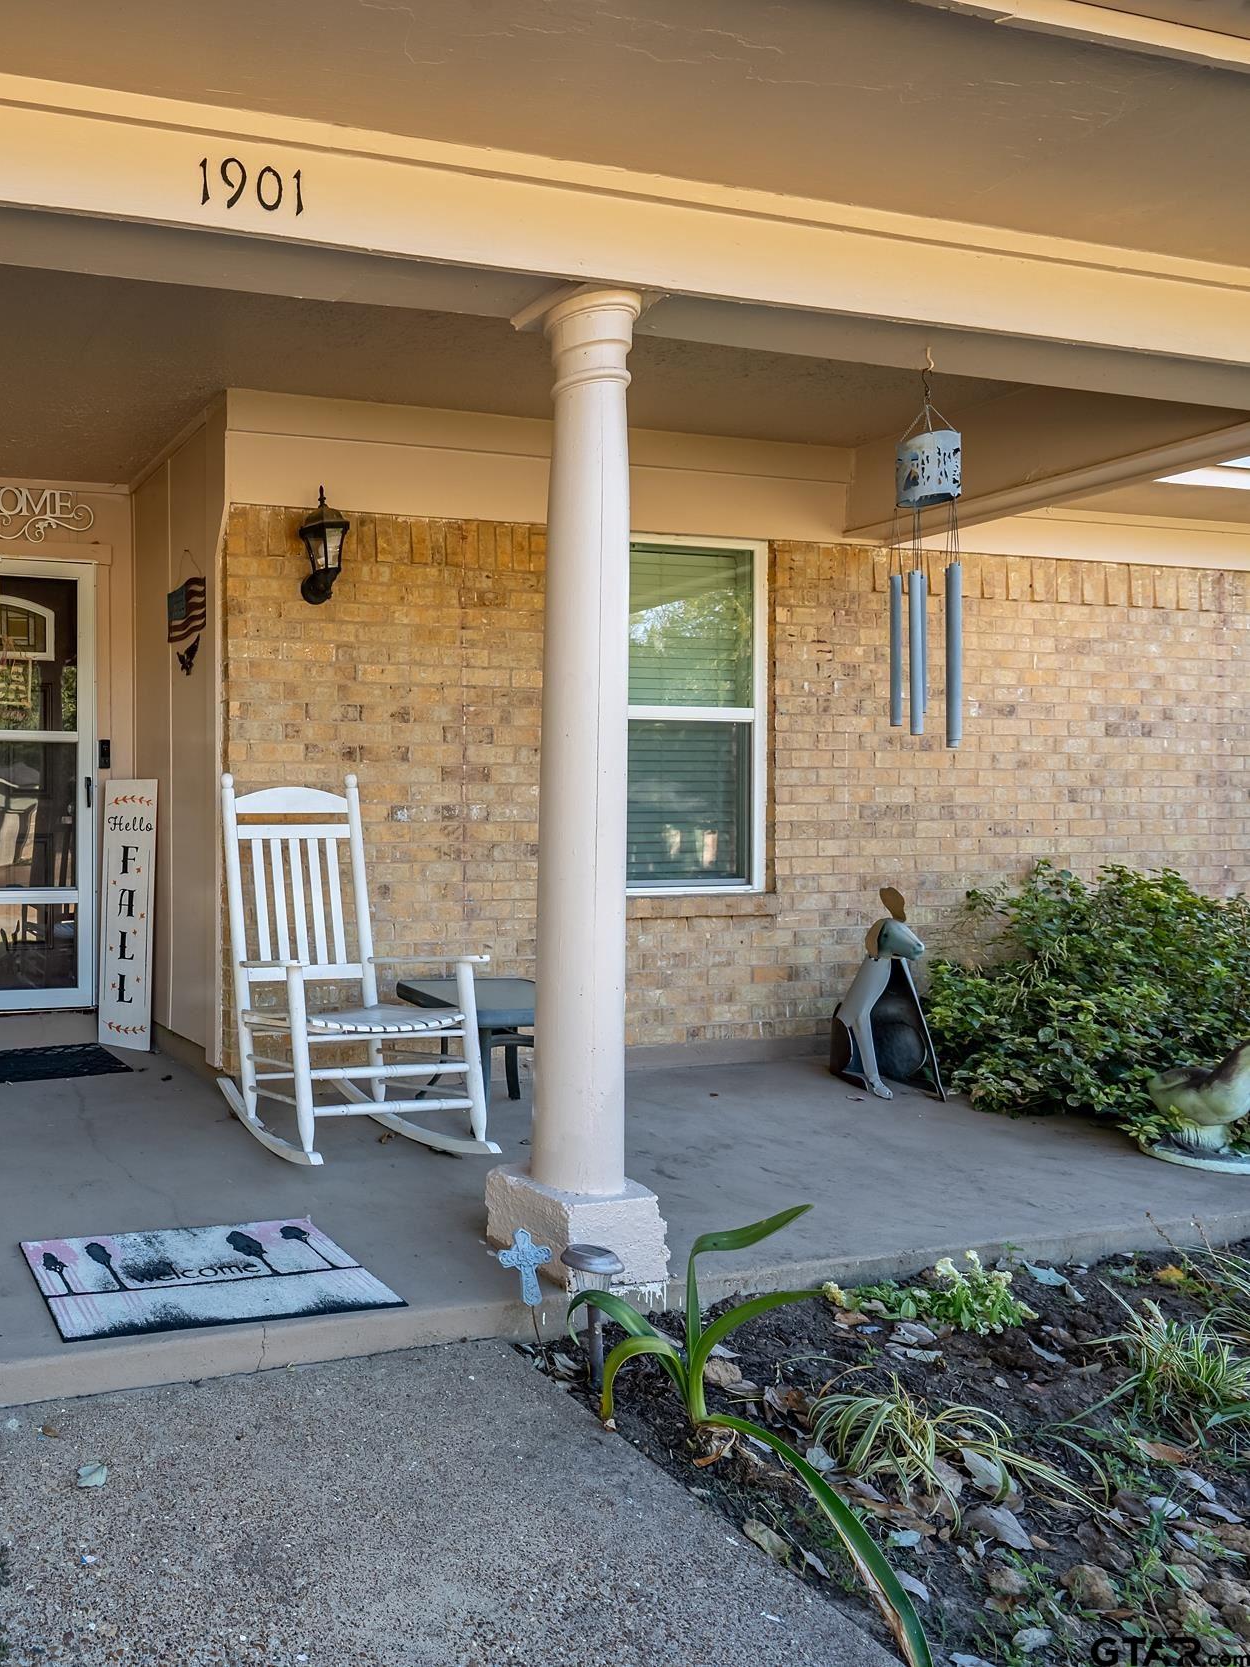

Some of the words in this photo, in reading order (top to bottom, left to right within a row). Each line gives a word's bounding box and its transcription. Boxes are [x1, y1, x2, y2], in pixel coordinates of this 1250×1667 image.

[199, 157, 304, 217] 1901
[107, 815, 154, 832] Hello
[116, 845, 139, 1004] FALL
[129, 1258, 261, 1284] welcome
